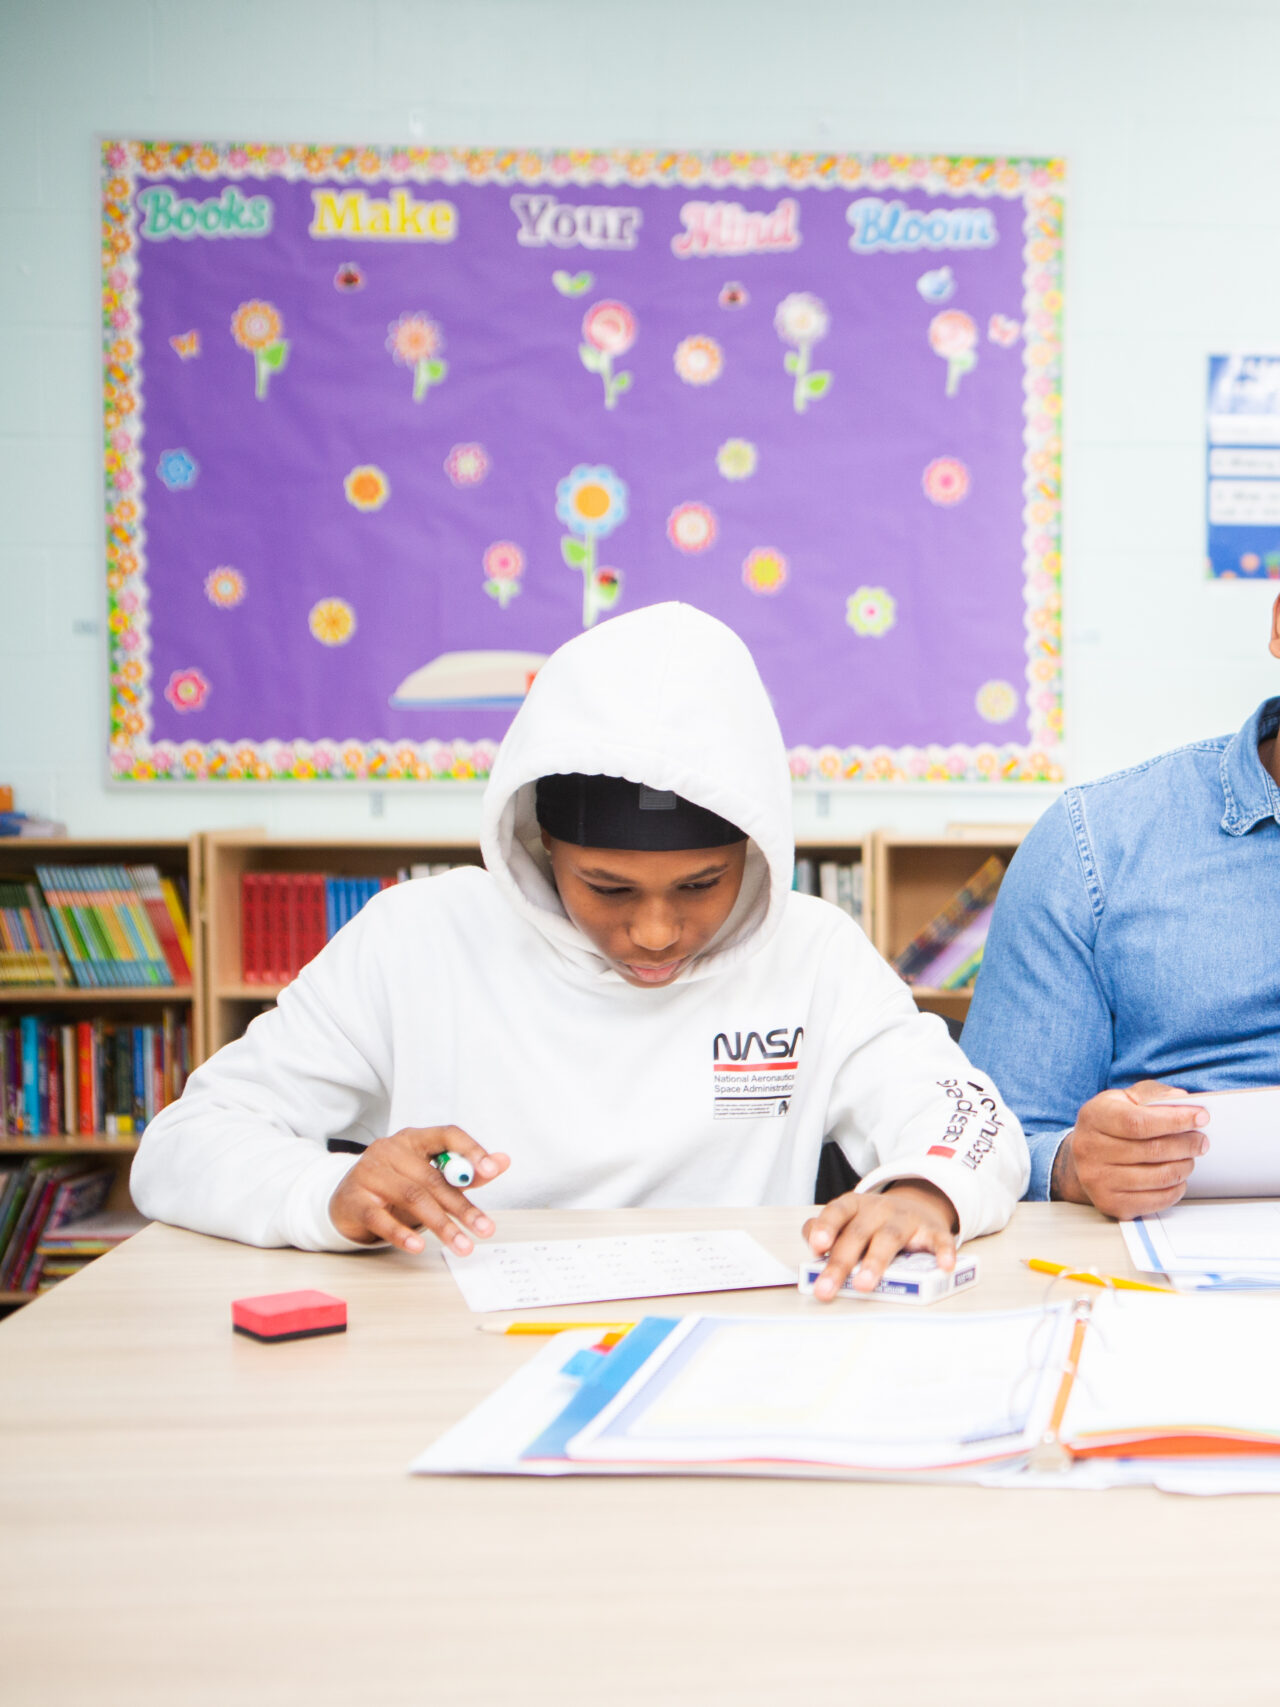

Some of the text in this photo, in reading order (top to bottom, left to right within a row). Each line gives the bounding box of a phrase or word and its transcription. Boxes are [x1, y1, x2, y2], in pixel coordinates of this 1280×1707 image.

[141, 187, 997, 257] Books Make Your Mind Bloom
[713, 1074, 749, 1084] National
[714, 1084, 741, 1094] Space
